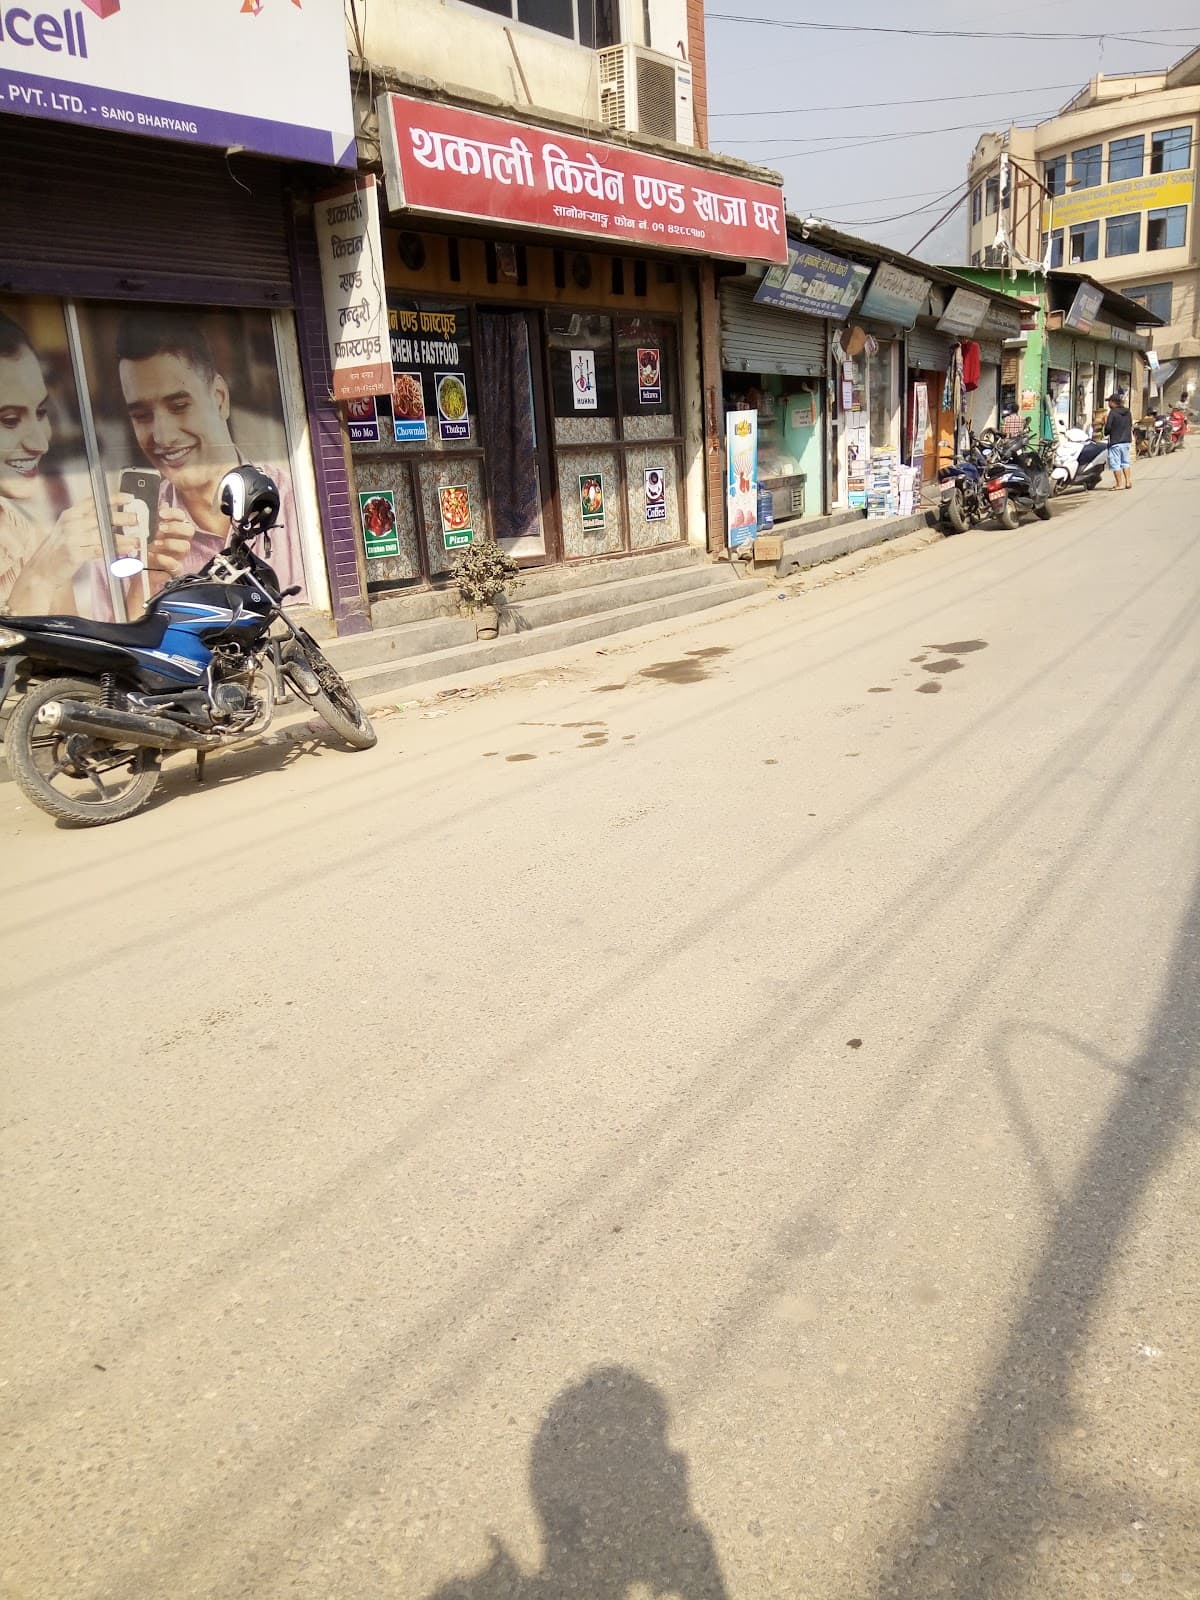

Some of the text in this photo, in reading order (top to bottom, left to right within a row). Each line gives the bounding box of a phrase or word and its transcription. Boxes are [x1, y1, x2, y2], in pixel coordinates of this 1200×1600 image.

[0, 7, 88, 59] cell
[8, 84, 48, 107] PVT.
[51, 92, 88, 114] LTD.
[101, 105, 135, 123] SANO
[137, 114, 198, 134] BHARYANG
[409, 127, 781, 235] थकाली किचेन एण्ड खाजा घर
[326, 194, 362, 226] थकाली
[414, 340, 420, 364] &
[421, 341, 459, 366] FASTFOOD
[350, 427, 374, 438] Mo Mo
[449, 535, 469, 545] Pizza
